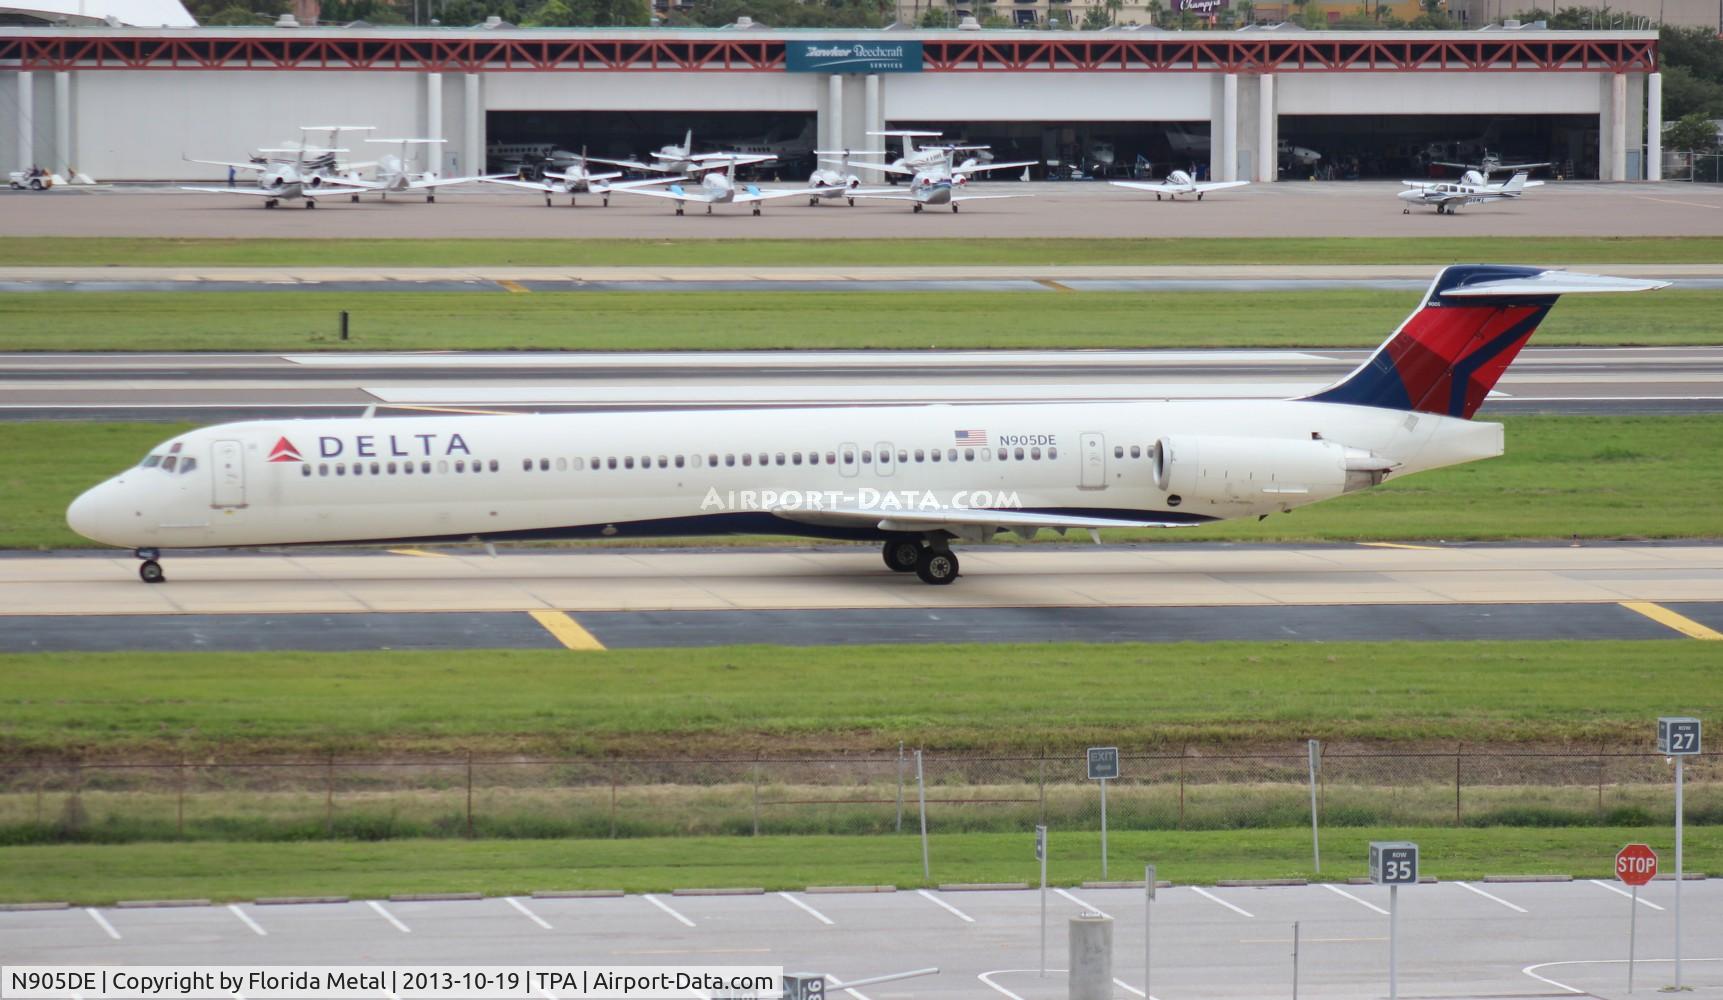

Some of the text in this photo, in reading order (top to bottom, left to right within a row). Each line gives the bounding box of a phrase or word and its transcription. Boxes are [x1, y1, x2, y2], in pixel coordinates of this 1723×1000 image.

[854, 44, 904, 57] Beechcraft
[319, 433, 471, 458] DELTA
[999, 434, 1057, 447] N905DE
[1672, 733, 1695, 750] 27
[1090, 751, 1115, 761] EXIT
[1385, 860, 1412, 880] 35
[1617, 856, 1656, 874] STOP
